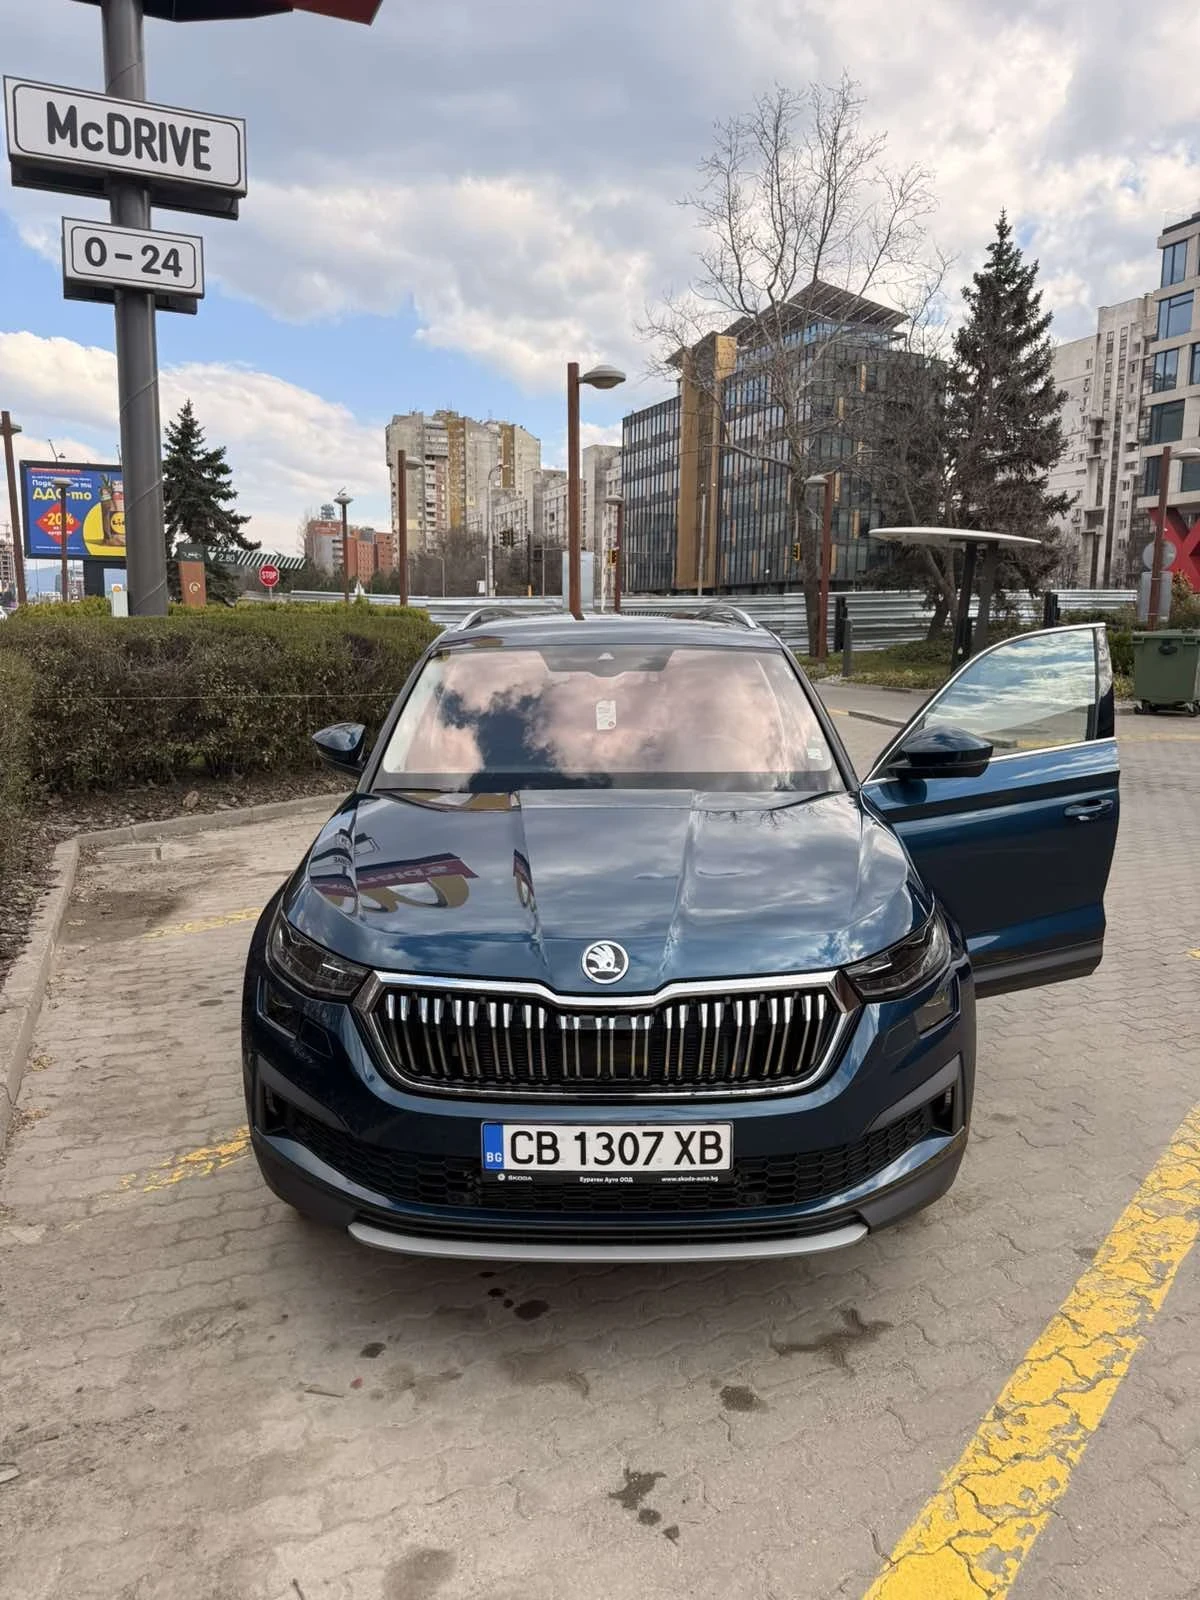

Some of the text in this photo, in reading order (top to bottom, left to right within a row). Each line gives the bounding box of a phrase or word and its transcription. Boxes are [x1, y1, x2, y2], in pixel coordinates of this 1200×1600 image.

[46, 101, 212, 172] McDRIVE
[261, 570, 277, 579] STOP
[486, 1152, 503, 1163] BG
[510, 1130, 724, 1166] CB 1307 XB
